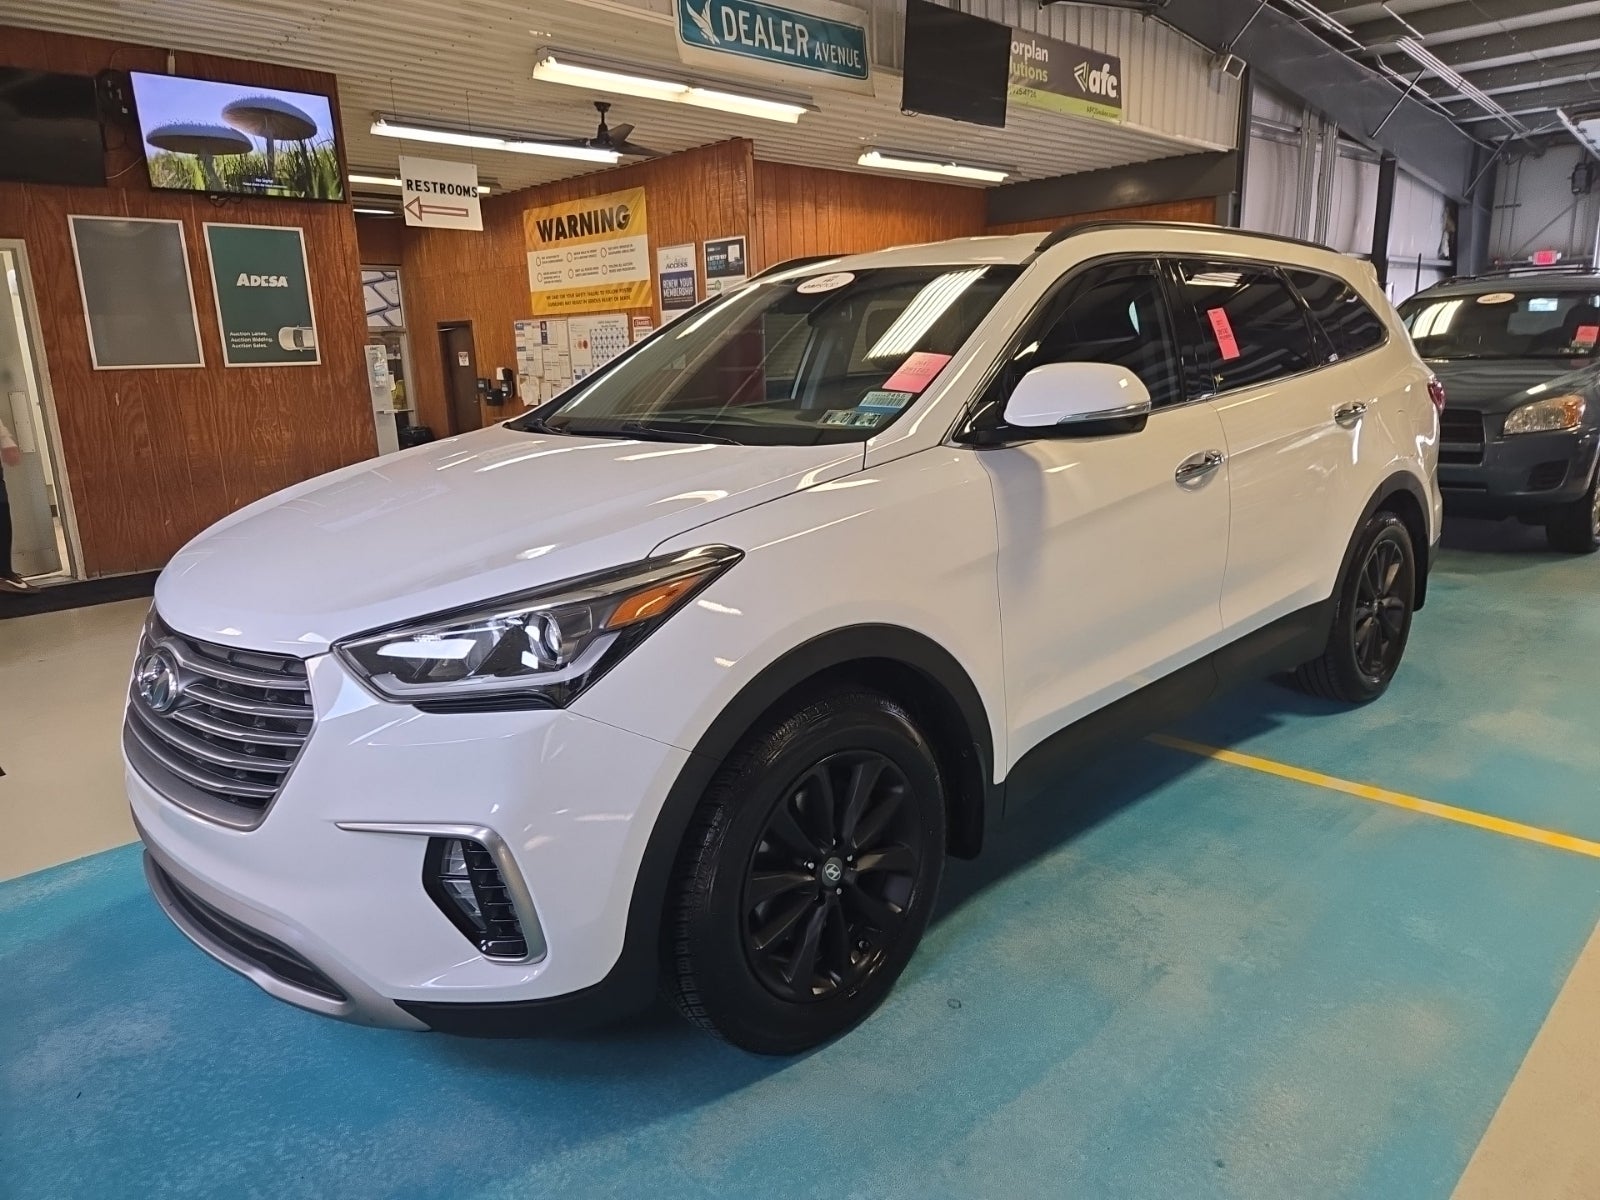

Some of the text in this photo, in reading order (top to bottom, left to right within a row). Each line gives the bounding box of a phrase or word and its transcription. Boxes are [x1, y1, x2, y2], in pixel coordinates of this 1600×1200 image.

[720, 5, 862, 69] DEALER AVENUE
[1088, 63, 1118, 98] afc
[406, 179, 478, 198] RESTROOMS
[536, 204, 631, 243] WARNING
[236, 273, 289, 288] ADESA
[663, 277, 693, 289] RENEW YOUR
[663, 287, 693, 298] MEMBERSHIP
